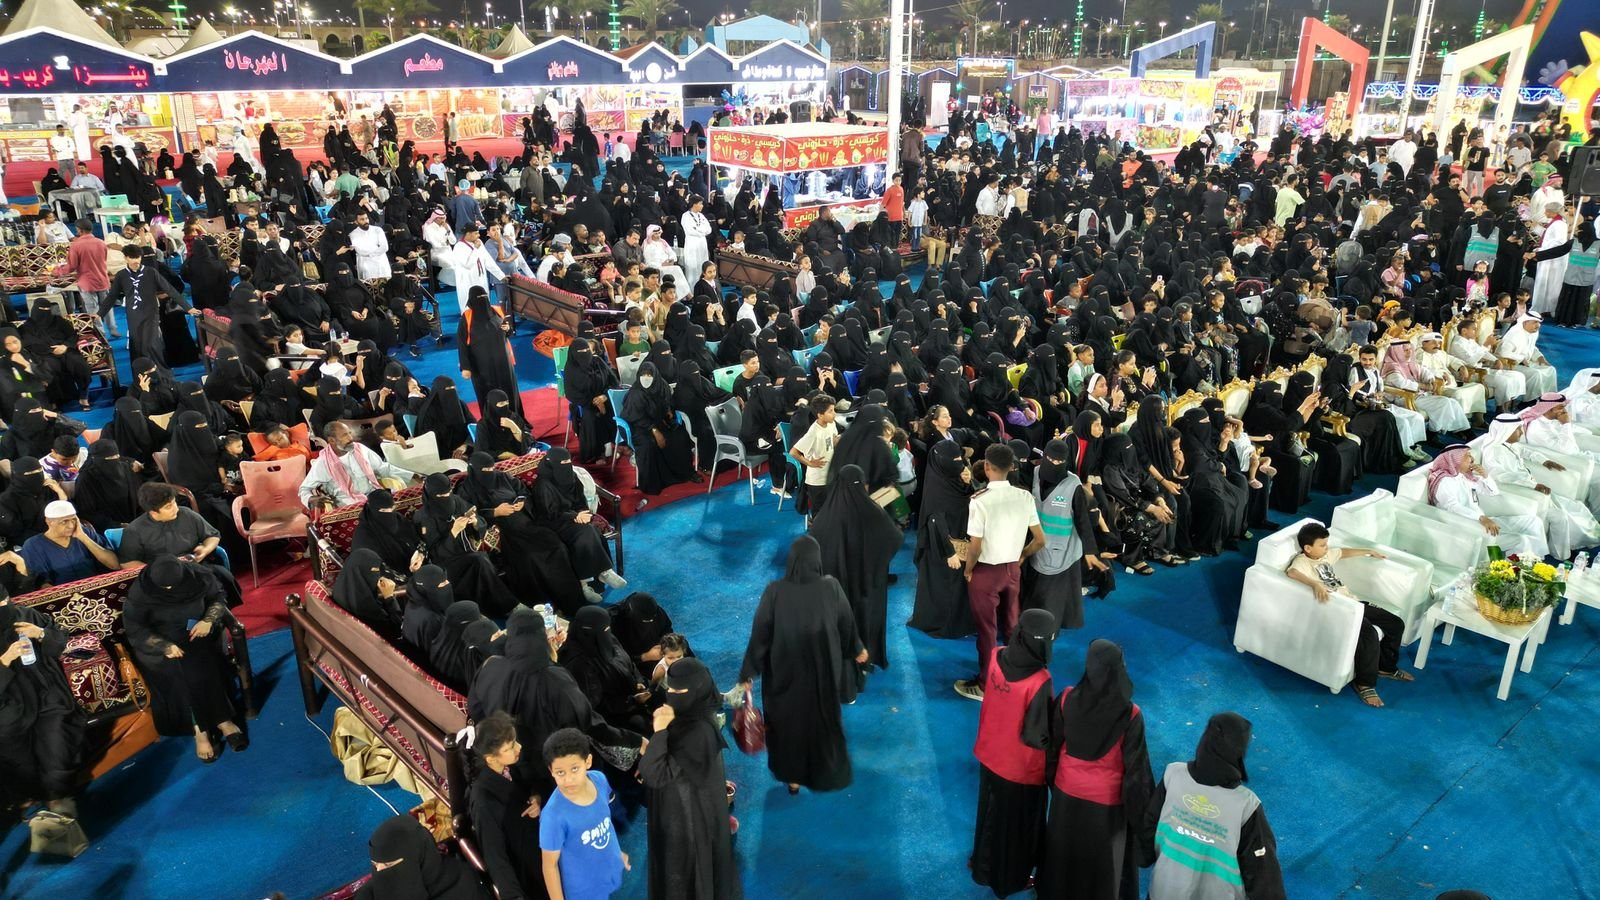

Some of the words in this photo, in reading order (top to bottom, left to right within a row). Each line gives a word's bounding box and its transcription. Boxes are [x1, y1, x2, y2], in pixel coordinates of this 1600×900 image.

[223, 48, 287, 76] المهرجان
[403, 52, 444, 78] مطعم
[22, 65, 54, 88] كريب
[713, 133, 737, 144] حلزوني
[740, 134, 751, 145] ذرة
[754, 139, 781, 149] كريسبي
[797, 138, 828, 152] حلزوني
[832, 136, 844, 148] ذرة
[849, 133, 880, 149] كريسبي
[794, 210, 819, 225] لزوني
